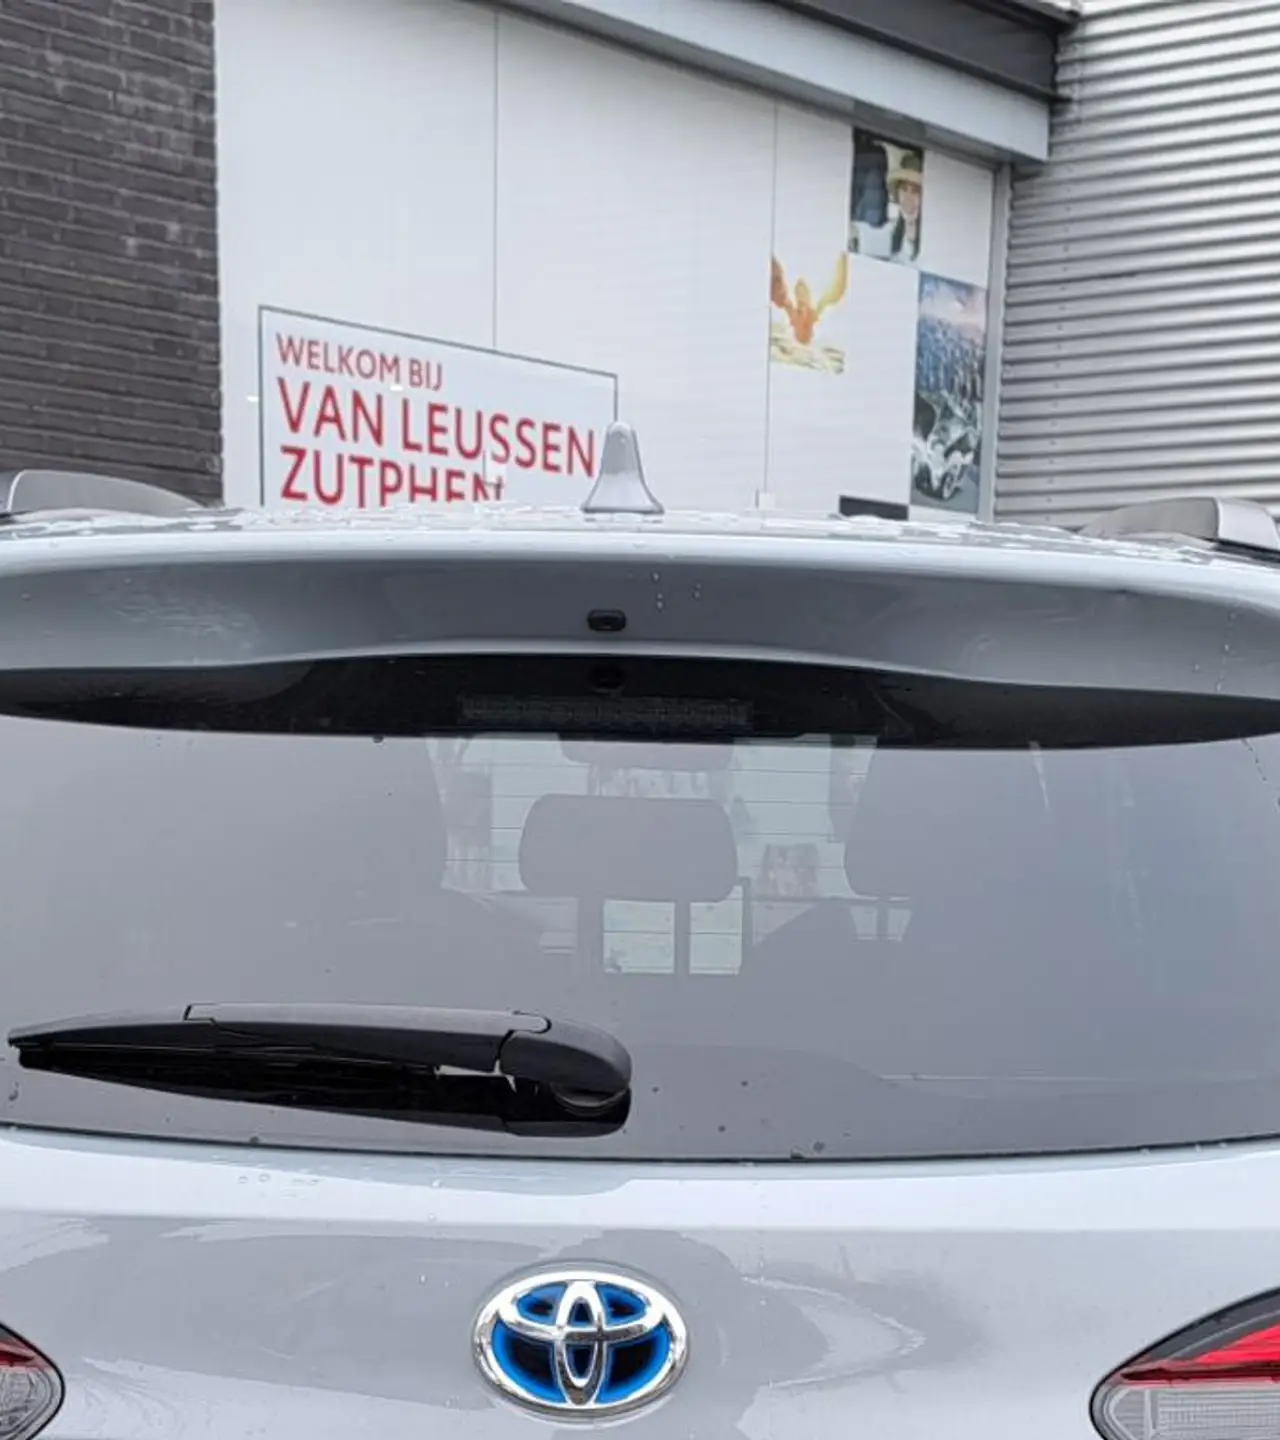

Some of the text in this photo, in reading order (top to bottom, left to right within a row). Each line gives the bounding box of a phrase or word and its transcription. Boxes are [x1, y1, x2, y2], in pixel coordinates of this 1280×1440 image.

[275, 331, 443, 391] WELKOM BIJ
[277, 376, 595, 477] VAN LEUSSEN
